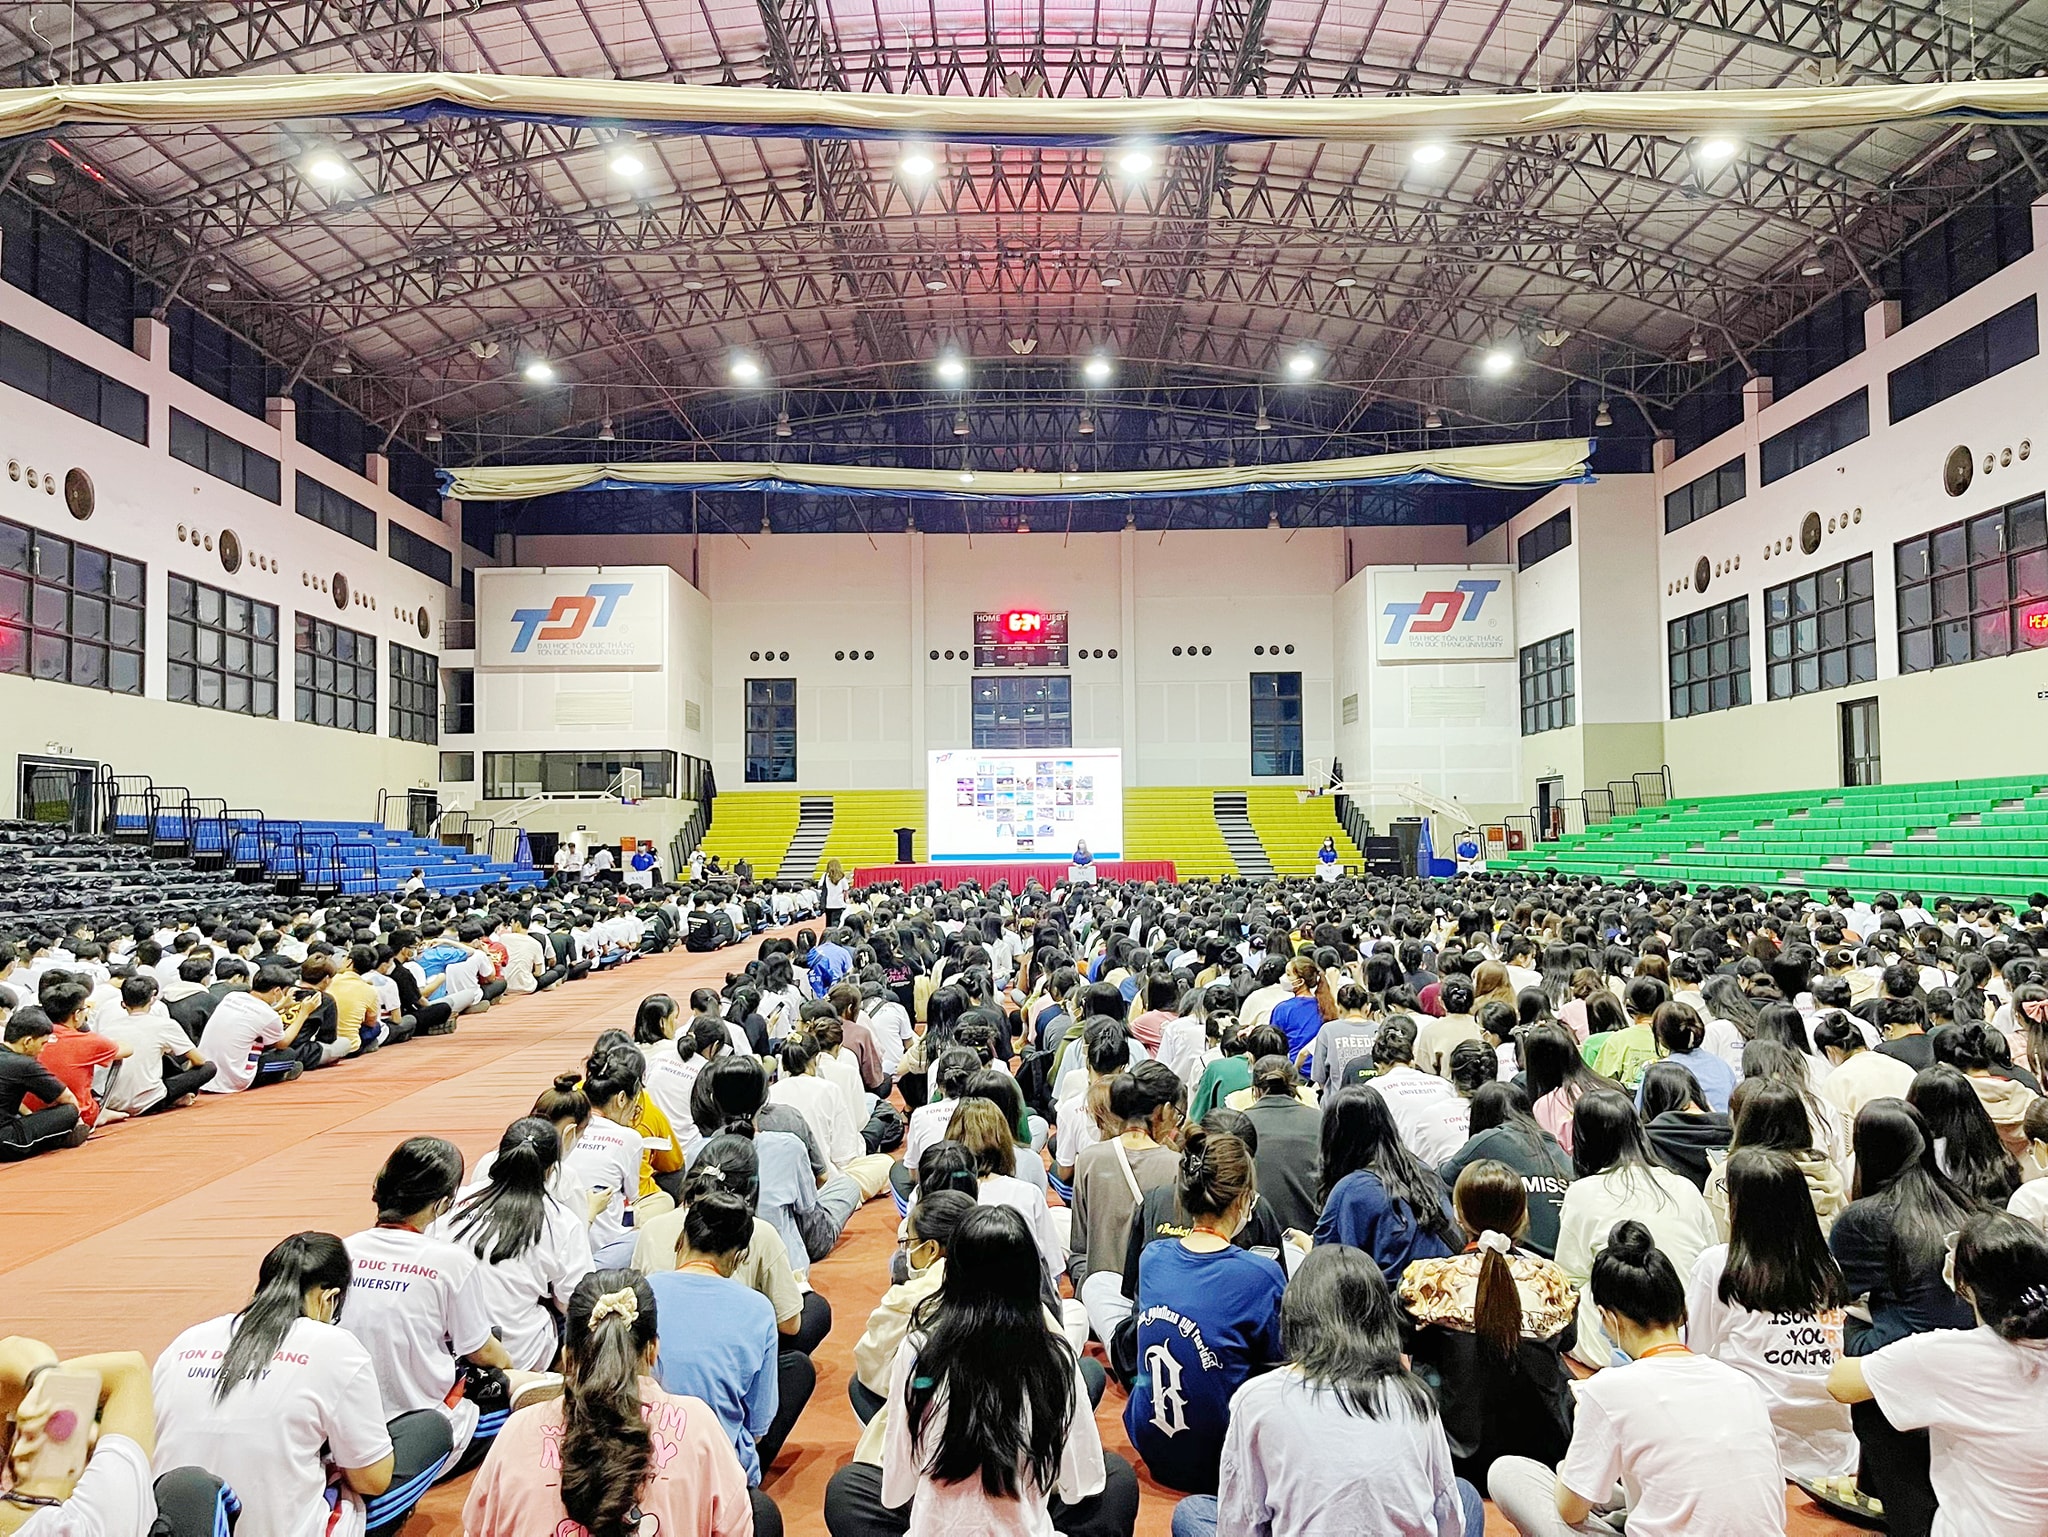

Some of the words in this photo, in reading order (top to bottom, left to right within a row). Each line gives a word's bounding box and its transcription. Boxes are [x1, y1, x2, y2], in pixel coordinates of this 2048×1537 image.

[511, 584, 633, 652] TDT
[976, 614, 1001, 622] HOME
[1040, 613, 1066, 621] GUEST
[1384, 580, 1501, 644] TDT
[1444, 1116, 1462, 1124] TON
[593, 1135, 624, 1147] THANG
[1520, 1176, 1569, 1194] MISS
[358, 1259, 387, 1271] DUC
[392, 1262, 439, 1280] THANG
[178, 1349, 207, 1361] TON
